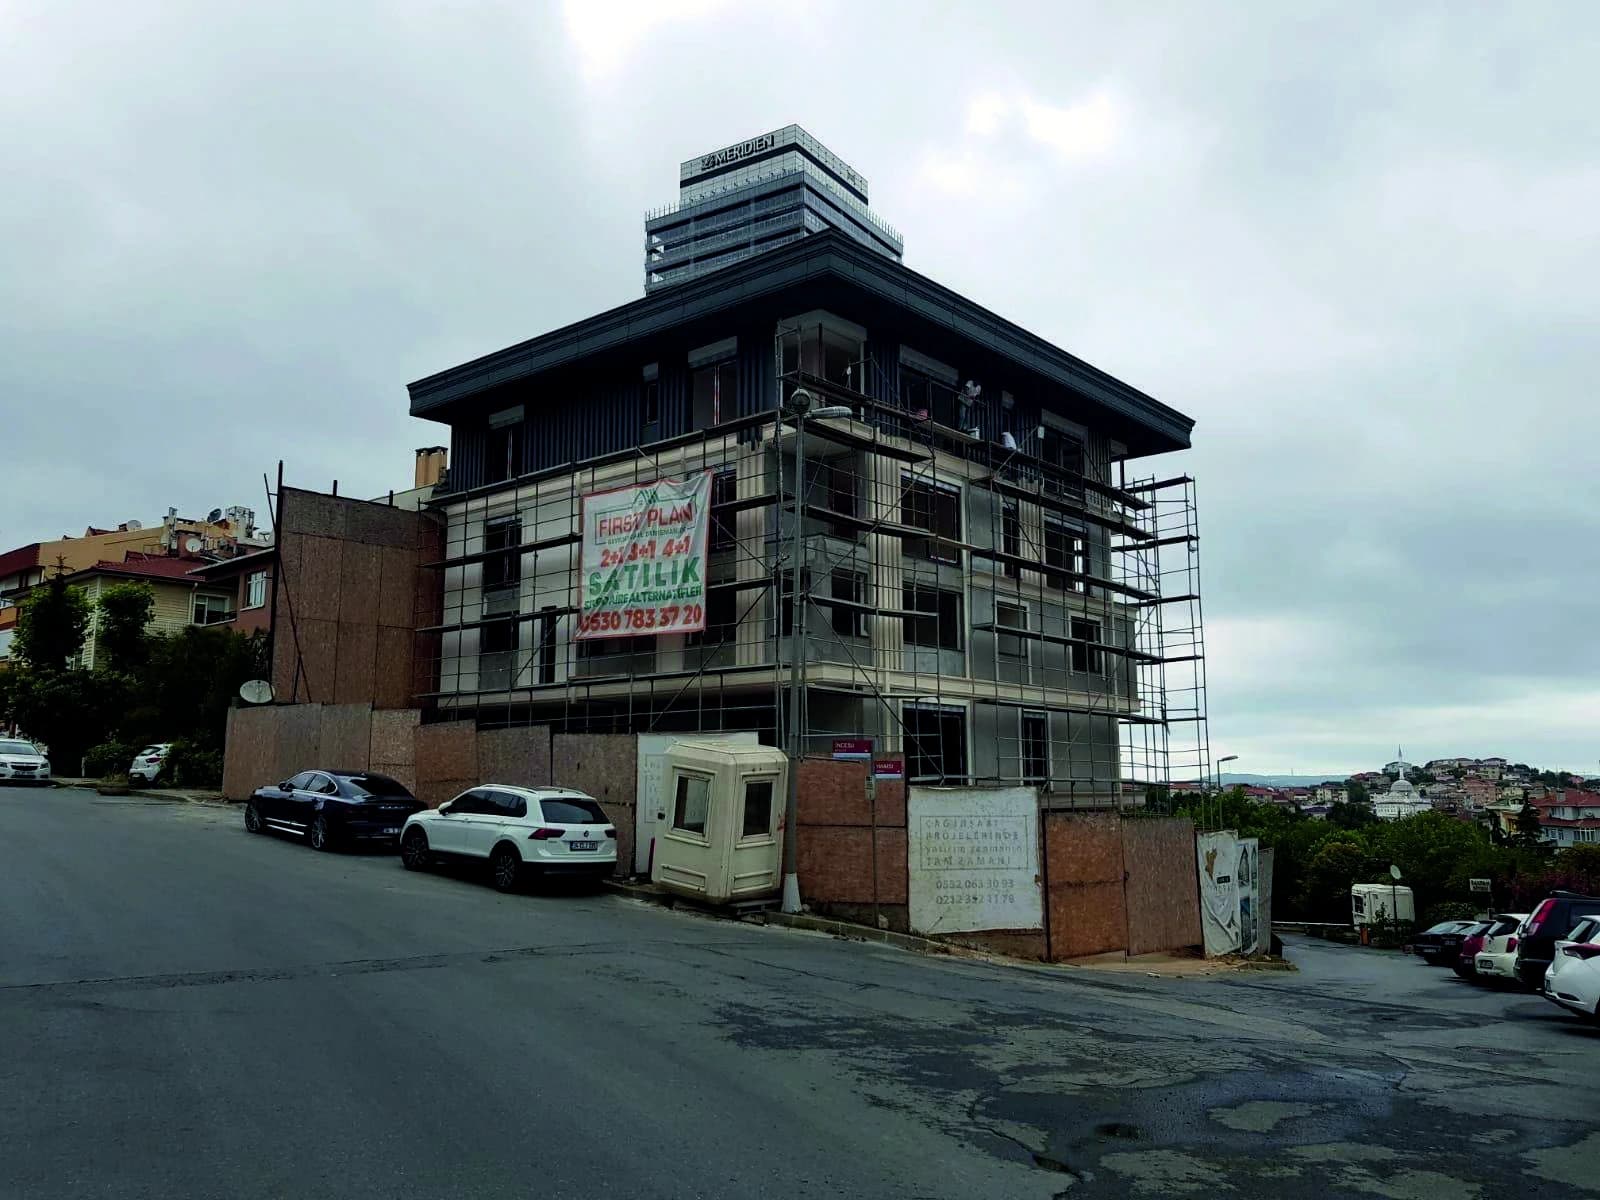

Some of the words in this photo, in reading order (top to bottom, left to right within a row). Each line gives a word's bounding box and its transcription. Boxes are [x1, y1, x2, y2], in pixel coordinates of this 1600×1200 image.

[599, 511, 643, 537] FIRST
[647, 502, 694, 528] PLAN
[600, 547, 624, 567] 2+1
[628, 539, 656, 561] 3+1
[662, 536, 690, 558] 4+1
[589, 556, 700, 596] SATILIK
[623, 608, 656, 629] 783
[682, 603, 702, 625] 20
